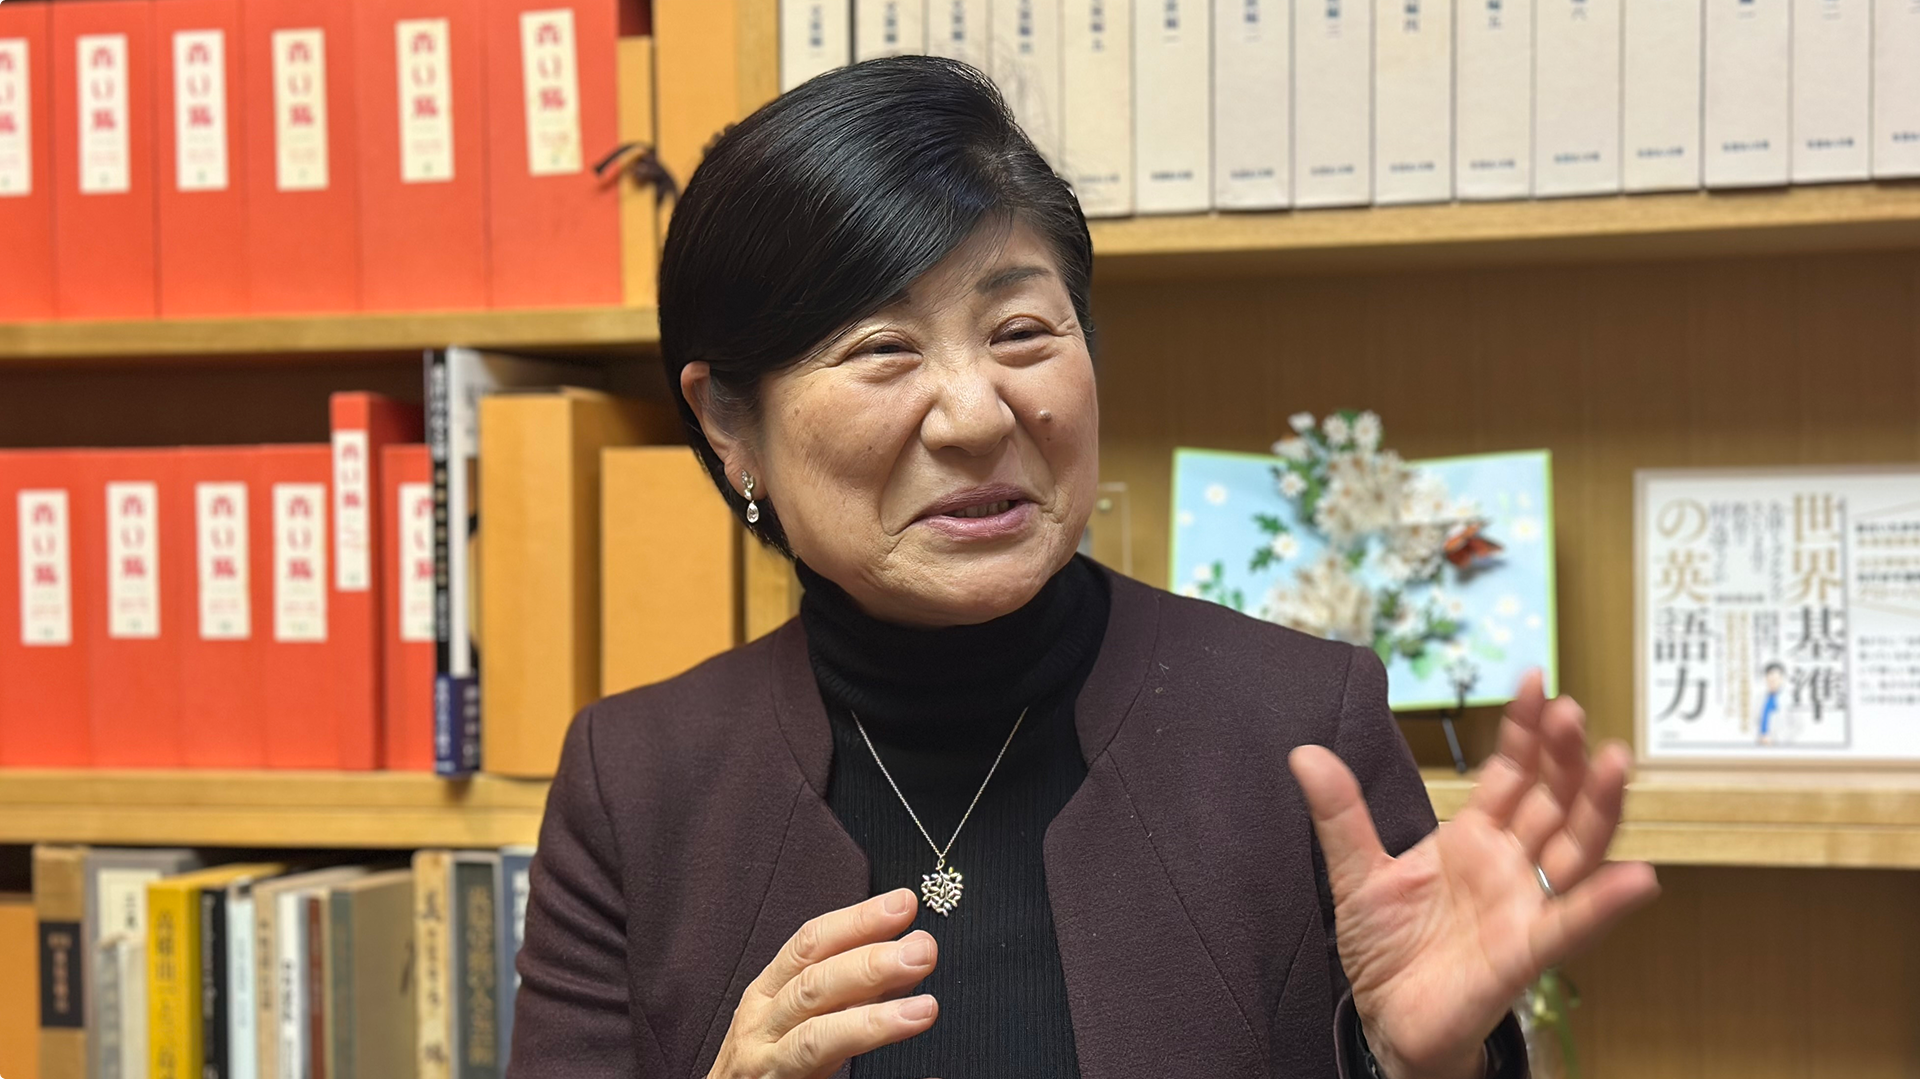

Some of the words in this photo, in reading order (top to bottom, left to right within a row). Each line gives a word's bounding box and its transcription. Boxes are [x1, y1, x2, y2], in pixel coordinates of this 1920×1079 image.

[1655, 498, 1710, 723] の英語力
[1785, 493, 1846, 722] 世界基準
